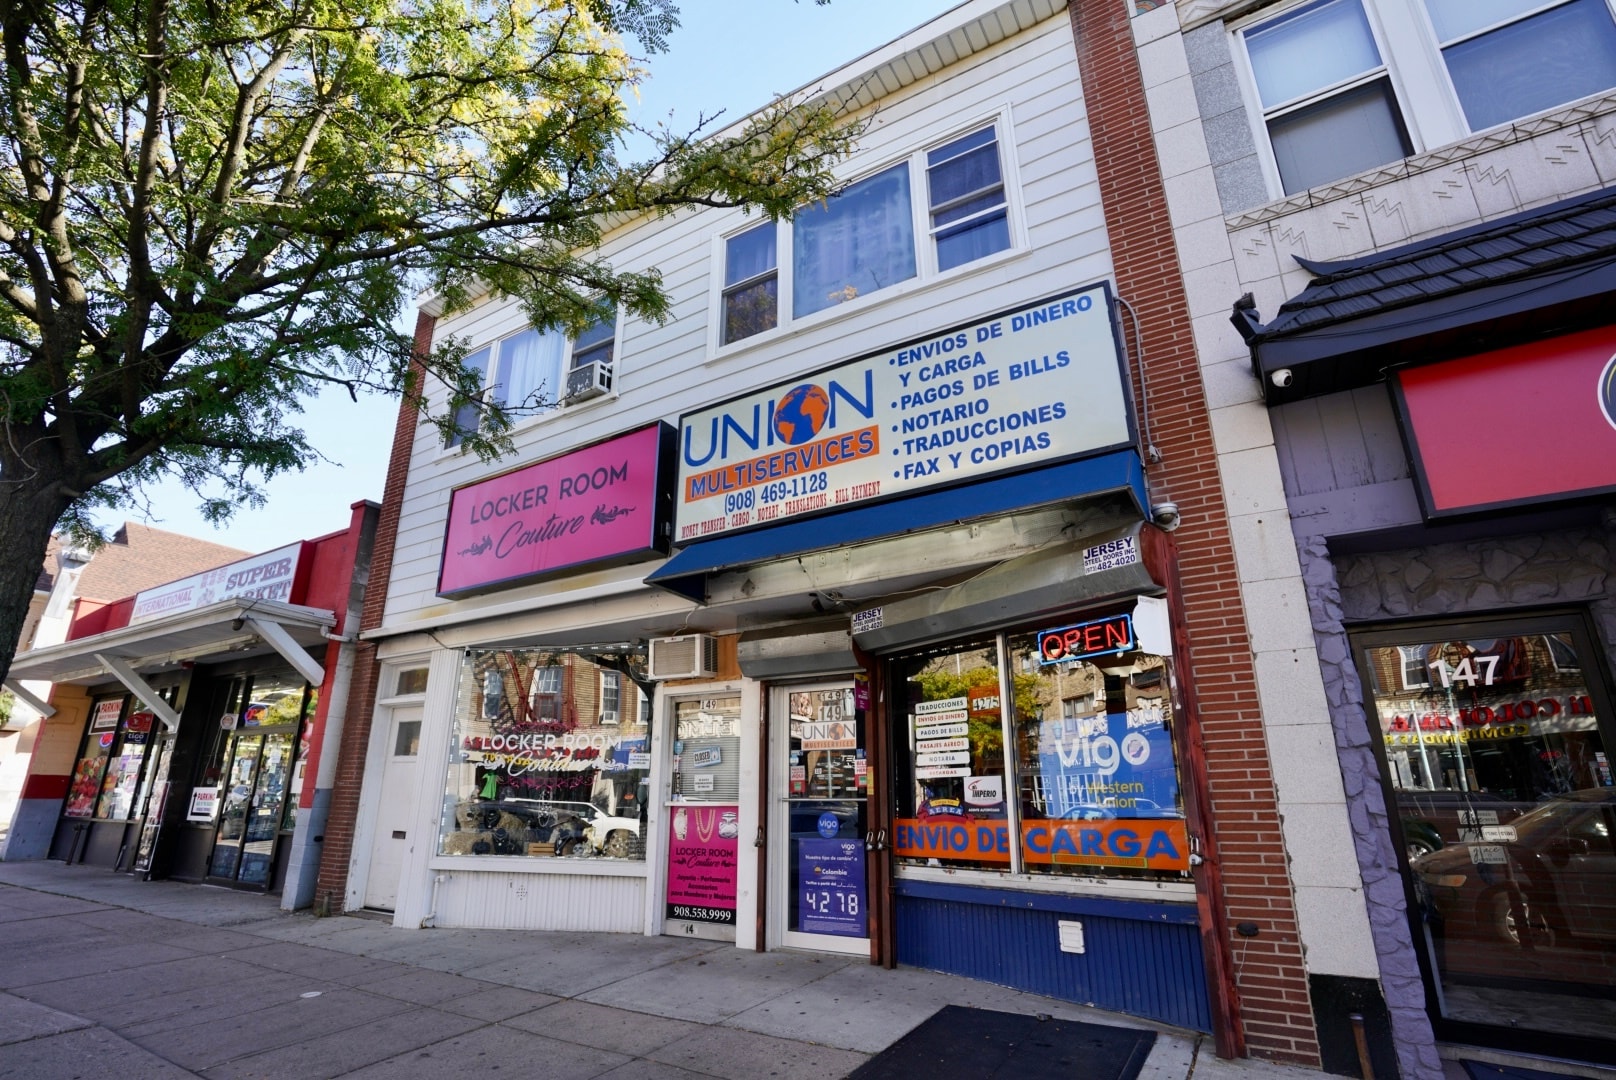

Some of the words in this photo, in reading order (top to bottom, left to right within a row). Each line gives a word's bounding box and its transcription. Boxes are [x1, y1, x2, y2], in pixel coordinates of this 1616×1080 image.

[897, 333, 968, 367] ENVIOS
[976, 322, 1003, 343] DE
[1011, 295, 1092, 332] DINERO
[899, 371, 911, 388] Y
[918, 351, 986, 382] CARGA
[900, 379, 964, 411] PAGOS
[973, 370, 1000, 390] DE
[1009, 350, 1070, 381] BILLS
[684, 369, 874, 467] UNION
[902, 398, 989, 434] NOTARIO
[903, 402, 1067, 456] TRADUCCIONES
[691, 430, 874, 499] MULTISERVICES
[903, 457, 940, 480] FAX
[948, 452, 962, 469] Y
[970, 431, 1051, 465] COPIAS
[470, 484, 548, 526] LOCKER
[559, 460, 628, 500] ROOM
[724, 487, 756, 516] (908)
[761, 471, 828, 504] 469-1128
[681, 523, 699, 539] MONEY
[701, 516, 726, 534] TRANSFER
[732, 511, 750, 527] CARGO
[757, 505, 779, 522] NOTARY
[785, 493, 827, 516] TRANSLATIONS
[835, 488, 849, 504] BILL
[851, 480, 881, 501] PAYMENT
[495, 513, 585, 559] Couture
[1084, 536, 1133, 560] JERSEY
[1084, 557, 1102, 567] STEEL
[1103, 550, 1123, 561] DOORS
[1097, 554, 1136, 571] 482-4020
[225, 556, 292, 592] SUPER
[134, 590, 193, 616] INTERNATIONAL
[853, 607, 882, 623] JERSEY
[1041, 618, 1128, 660] OPEN
[1428, 655, 1500, 689] 147
[701, 699, 717, 710] 149
[819, 706, 842, 721] 149
[918, 699, 964, 712] TRADUCCIONES
[918, 714, 937, 723] ENVIOS
[937, 713, 944, 721] DE
[945, 712, 965, 720] DINERO
[128, 733, 144, 742] tigo
[802, 722, 855, 740] UNION
[481, 734, 555, 750] LOCKER
[562, 734, 622, 750] ROOM
[803, 741, 854, 749] MULTISERVICES
[694, 750, 711, 762] CLOSED
[1055, 732, 1150, 776] vigo
[972, 789, 997, 798] IMPERIO
[1069, 781, 1084, 798] by
[1087, 781, 1144, 794] Western
[1097, 796, 1136, 809] Union
[819, 819, 838, 829] vigo
[841, 842, 855, 851] vigo
[896, 825, 970, 852] ENVIO
[976, 826, 1009, 853] DE
[1026, 827, 1180, 860] CARGA
[675, 847, 707, 857] LOCKER
[708, 848, 734, 858] ROOM
[686, 854, 720, 868] Couture
[821, 868, 848, 876] Colombia
[673, 905, 732, 921] 908.558.9999
